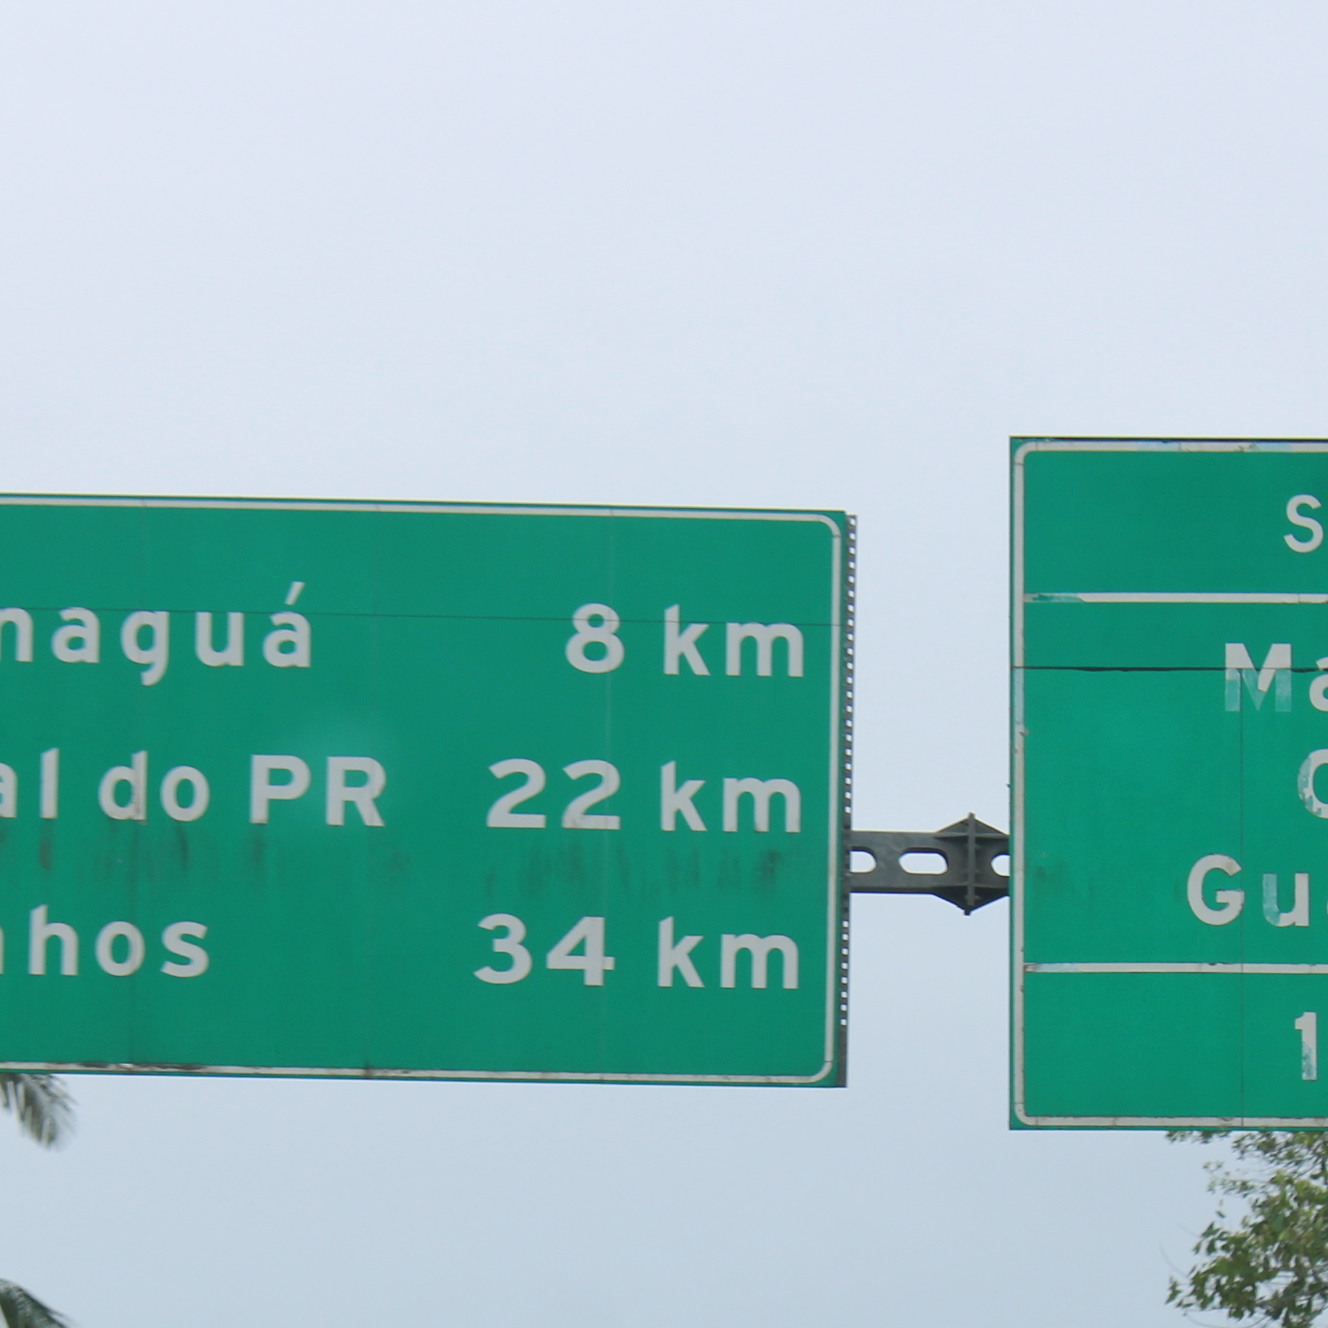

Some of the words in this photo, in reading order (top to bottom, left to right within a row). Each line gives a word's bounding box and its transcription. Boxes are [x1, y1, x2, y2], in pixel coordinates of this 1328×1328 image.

[564, 602, 626, 675] 8
[662, 603, 806, 679] km
[97, 750, 212, 825] do
[248, 754, 388, 828] PR
[485, 758, 622, 832] 22
[659, 760, 803, 834] km
[472, 912, 617, 987] 34
[656, 916, 801, 990] km
